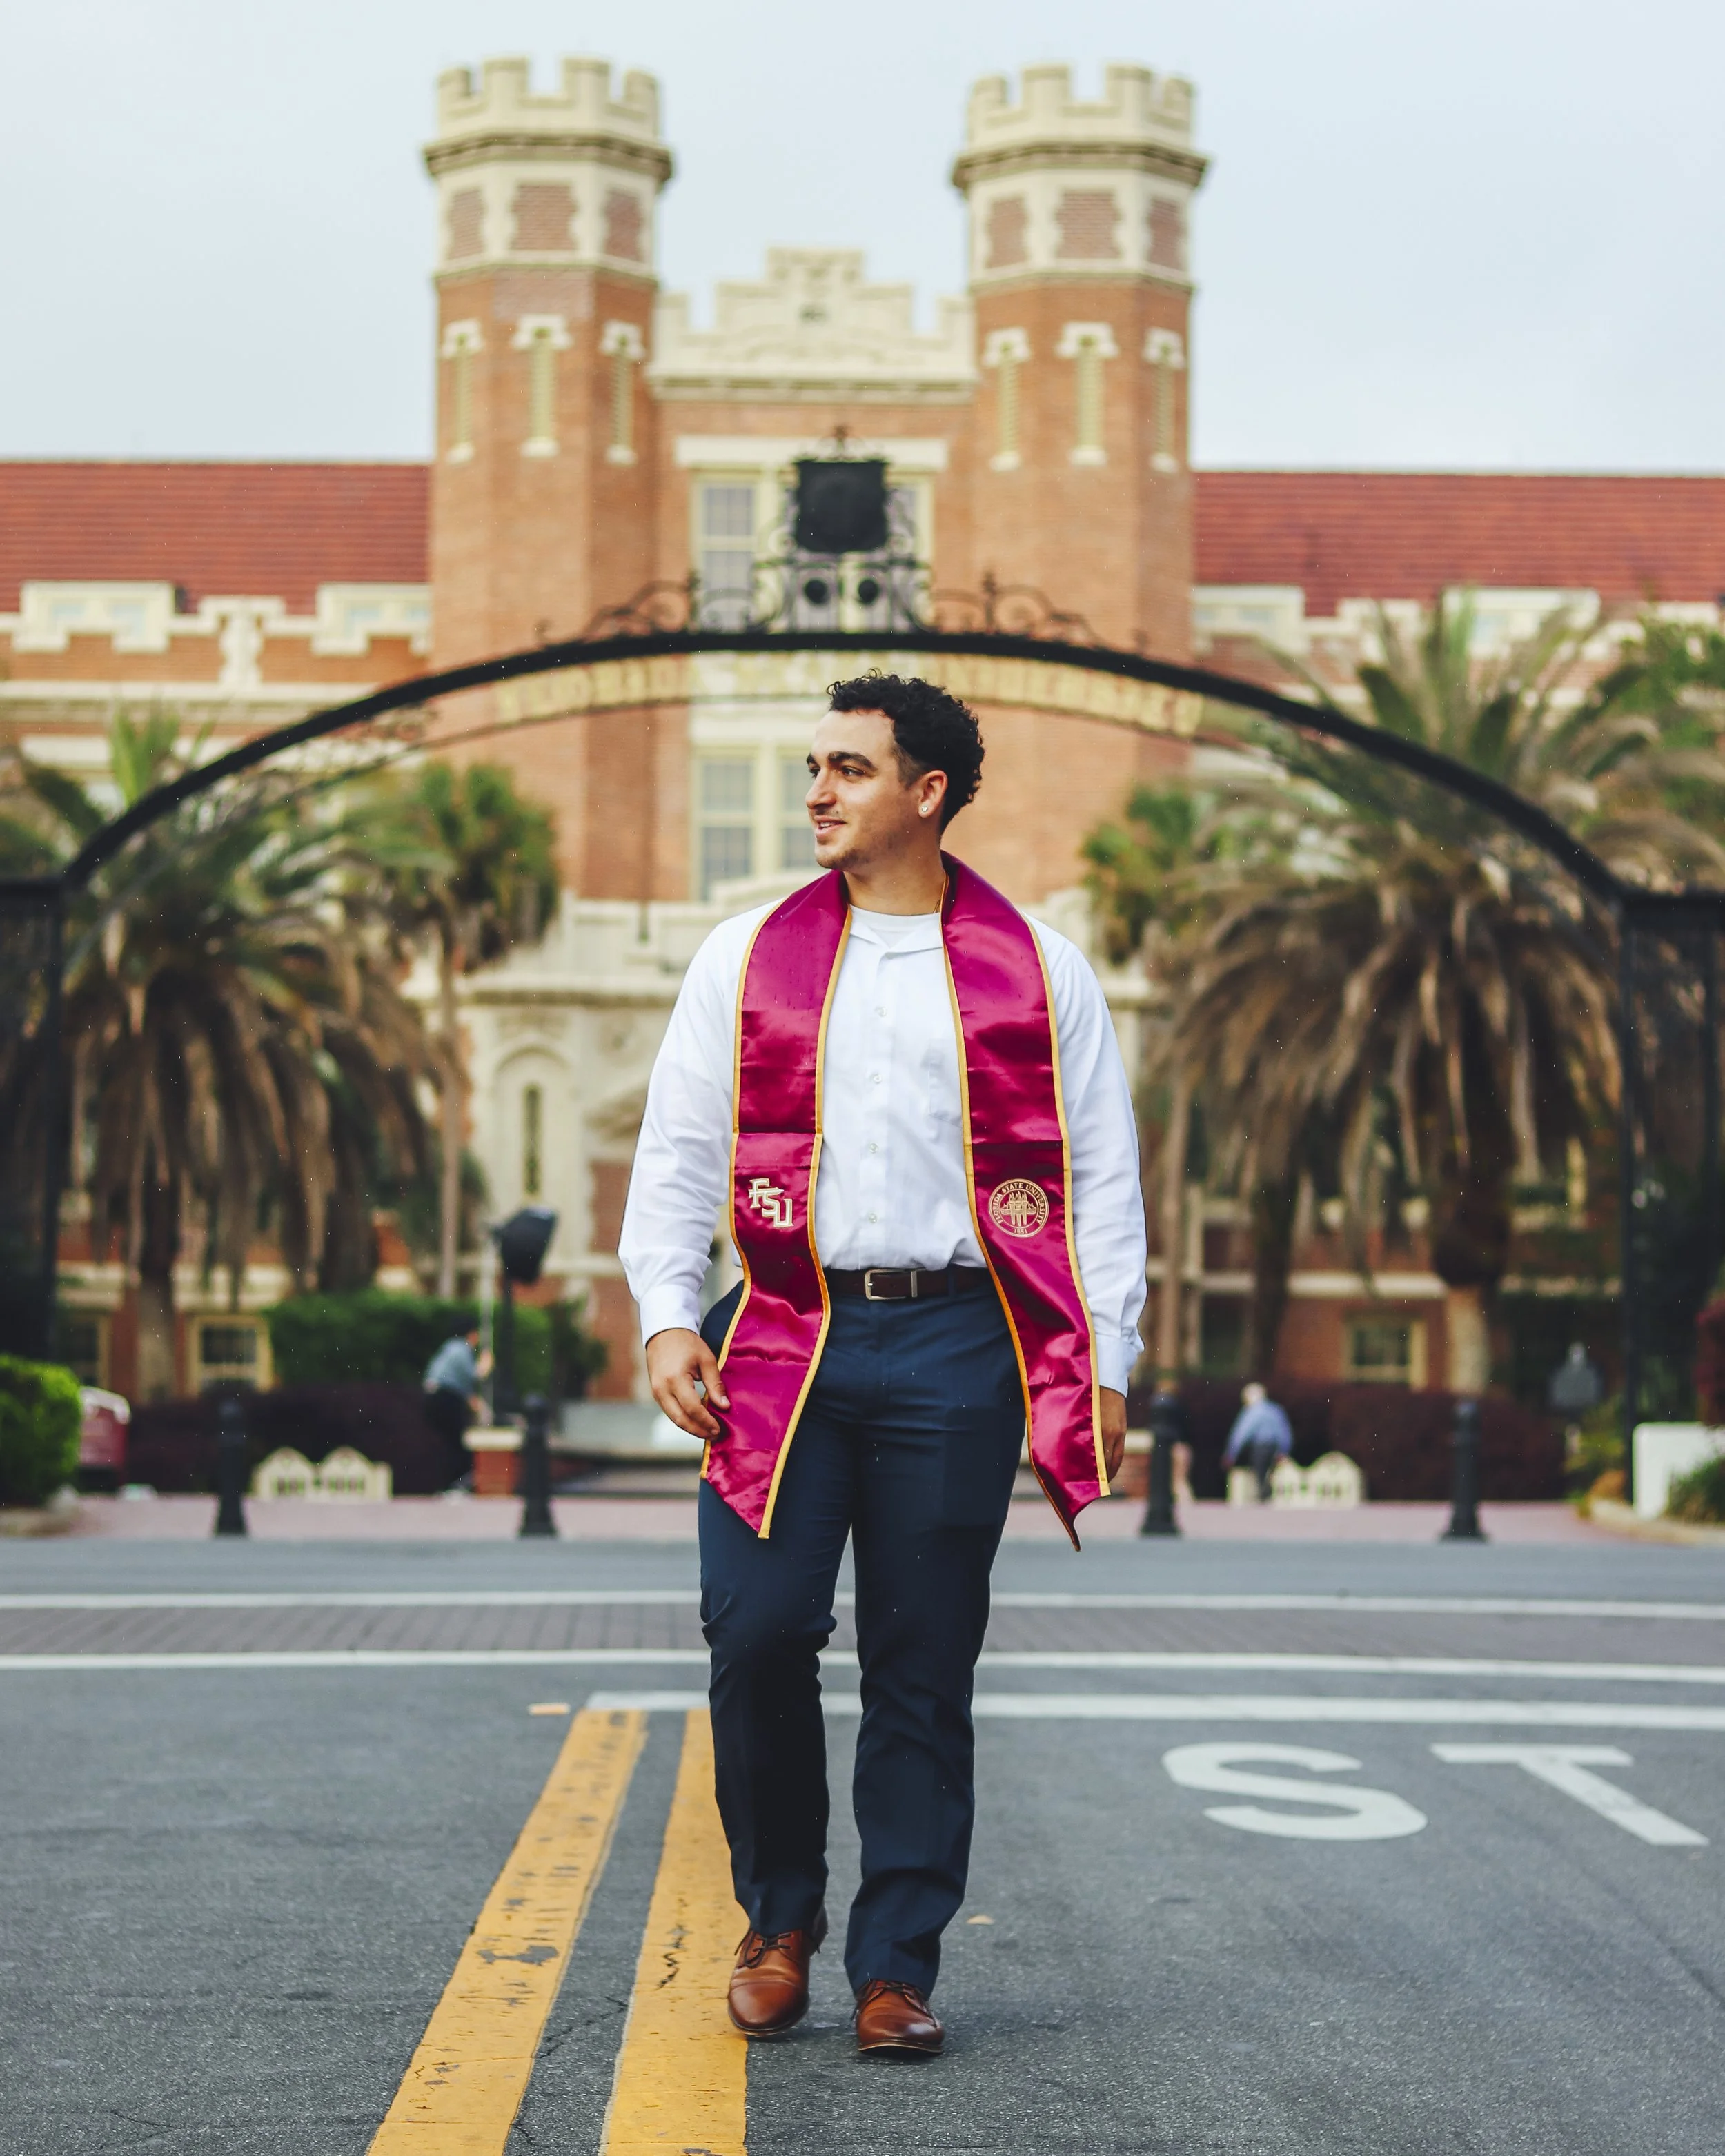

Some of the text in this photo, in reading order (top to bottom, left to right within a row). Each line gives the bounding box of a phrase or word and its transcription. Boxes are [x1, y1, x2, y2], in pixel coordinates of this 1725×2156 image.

[748, 1178, 794, 1228] FSU
[992, 1183, 1045, 1225] FLORIDA STATE UNIVERSITY
